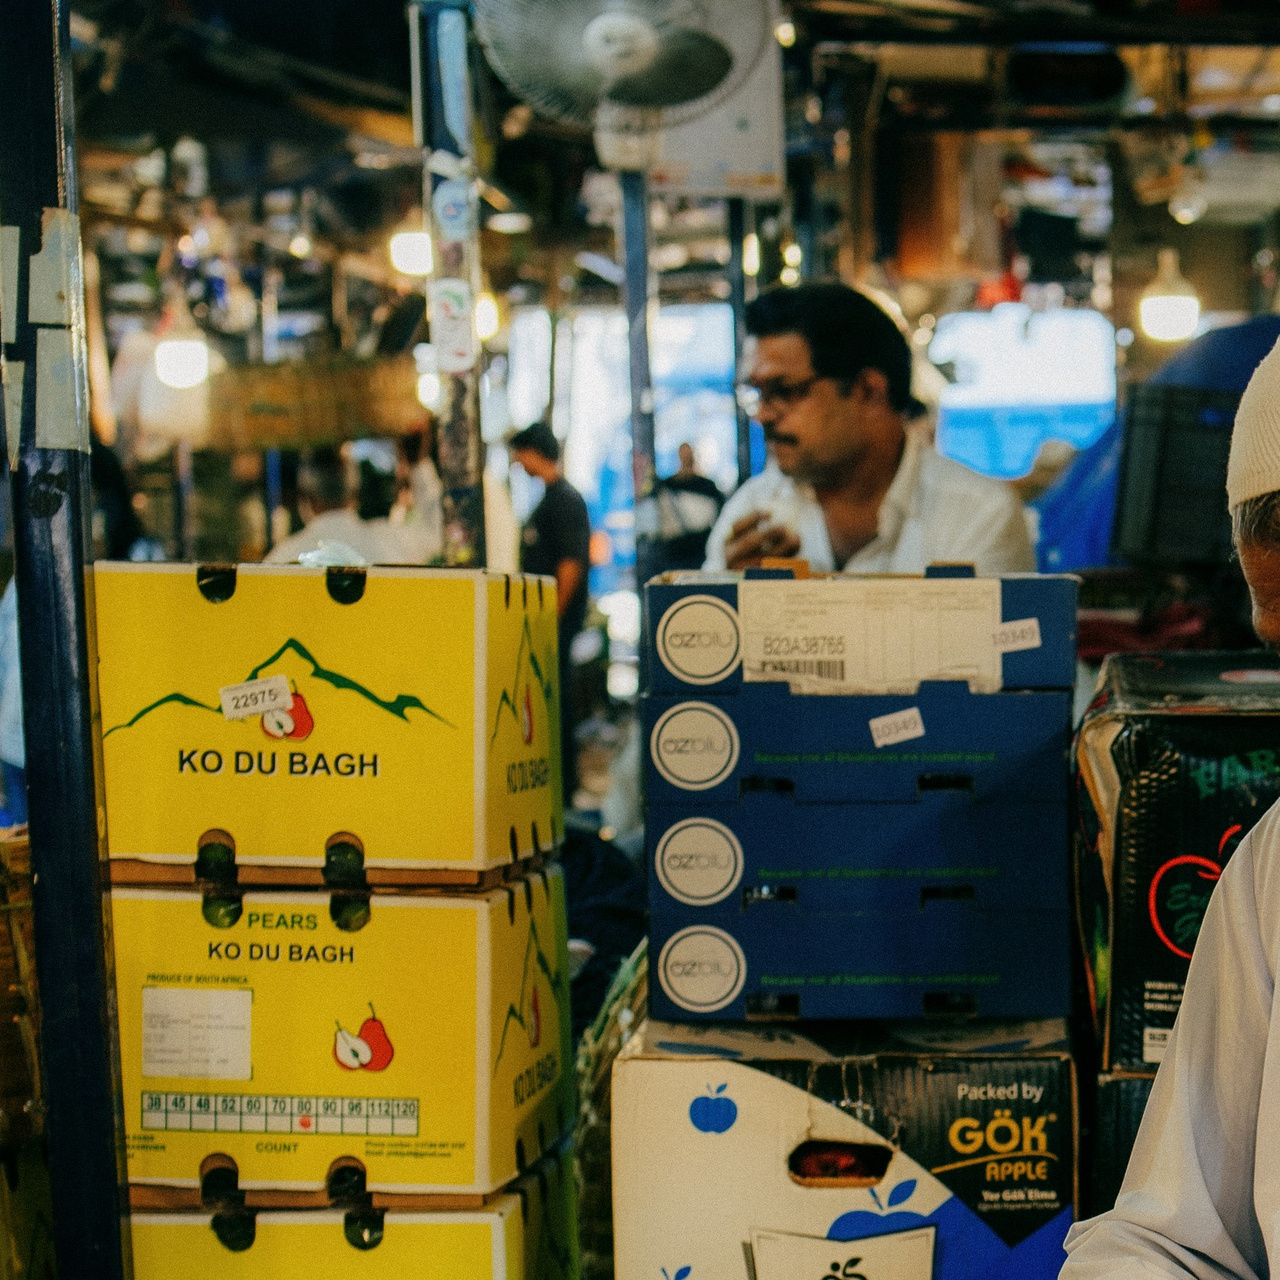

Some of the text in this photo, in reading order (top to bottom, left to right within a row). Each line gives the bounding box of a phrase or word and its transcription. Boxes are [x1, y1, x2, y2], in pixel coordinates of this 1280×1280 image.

[178, 750, 378, 777] KO DU BAGH
[247, 912, 318, 931] PEARS
[208, 942, 355, 963] KO DU BAGH
[957, 1082, 1044, 1103] Packed by
[272, 1099, 286, 1114] 70
[298, 1099, 311, 1114] 80
[323, 1100, 337, 1115] 90
[348, 1101, 362, 1115] 96
[370, 1101, 391, 1116] 112
[396, 1101, 416, 1117] 120
[948, 1108, 1048, 1155] GÖK
[256, 1142, 298, 1154] COUNT
[986, 1161, 1047, 1181] APPLE
